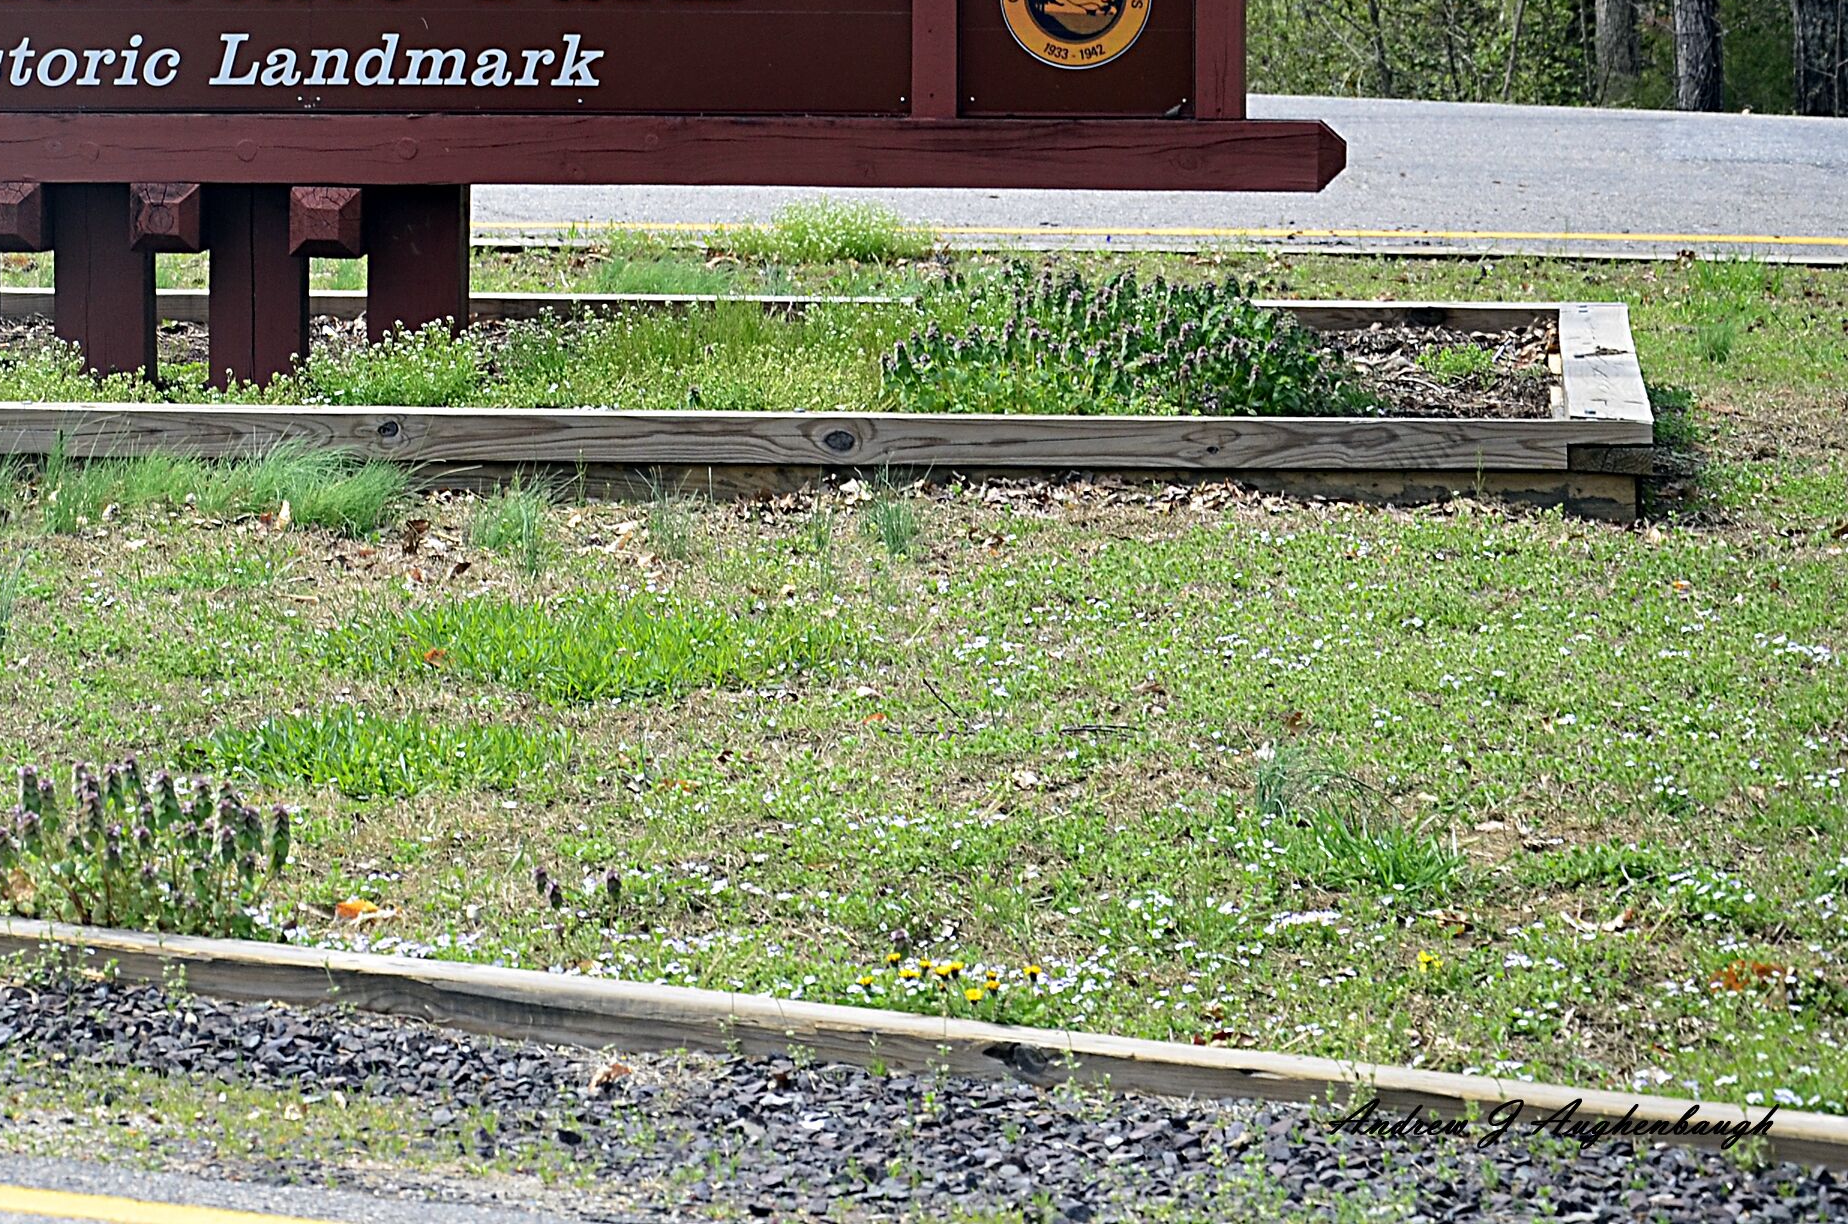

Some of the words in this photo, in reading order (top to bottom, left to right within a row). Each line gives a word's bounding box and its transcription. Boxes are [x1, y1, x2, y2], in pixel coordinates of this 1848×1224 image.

[208, 33, 604, 87] Landmark
[1043, 43, 1069, 60] 1933
[1079, 43, 1106, 60] 1942
